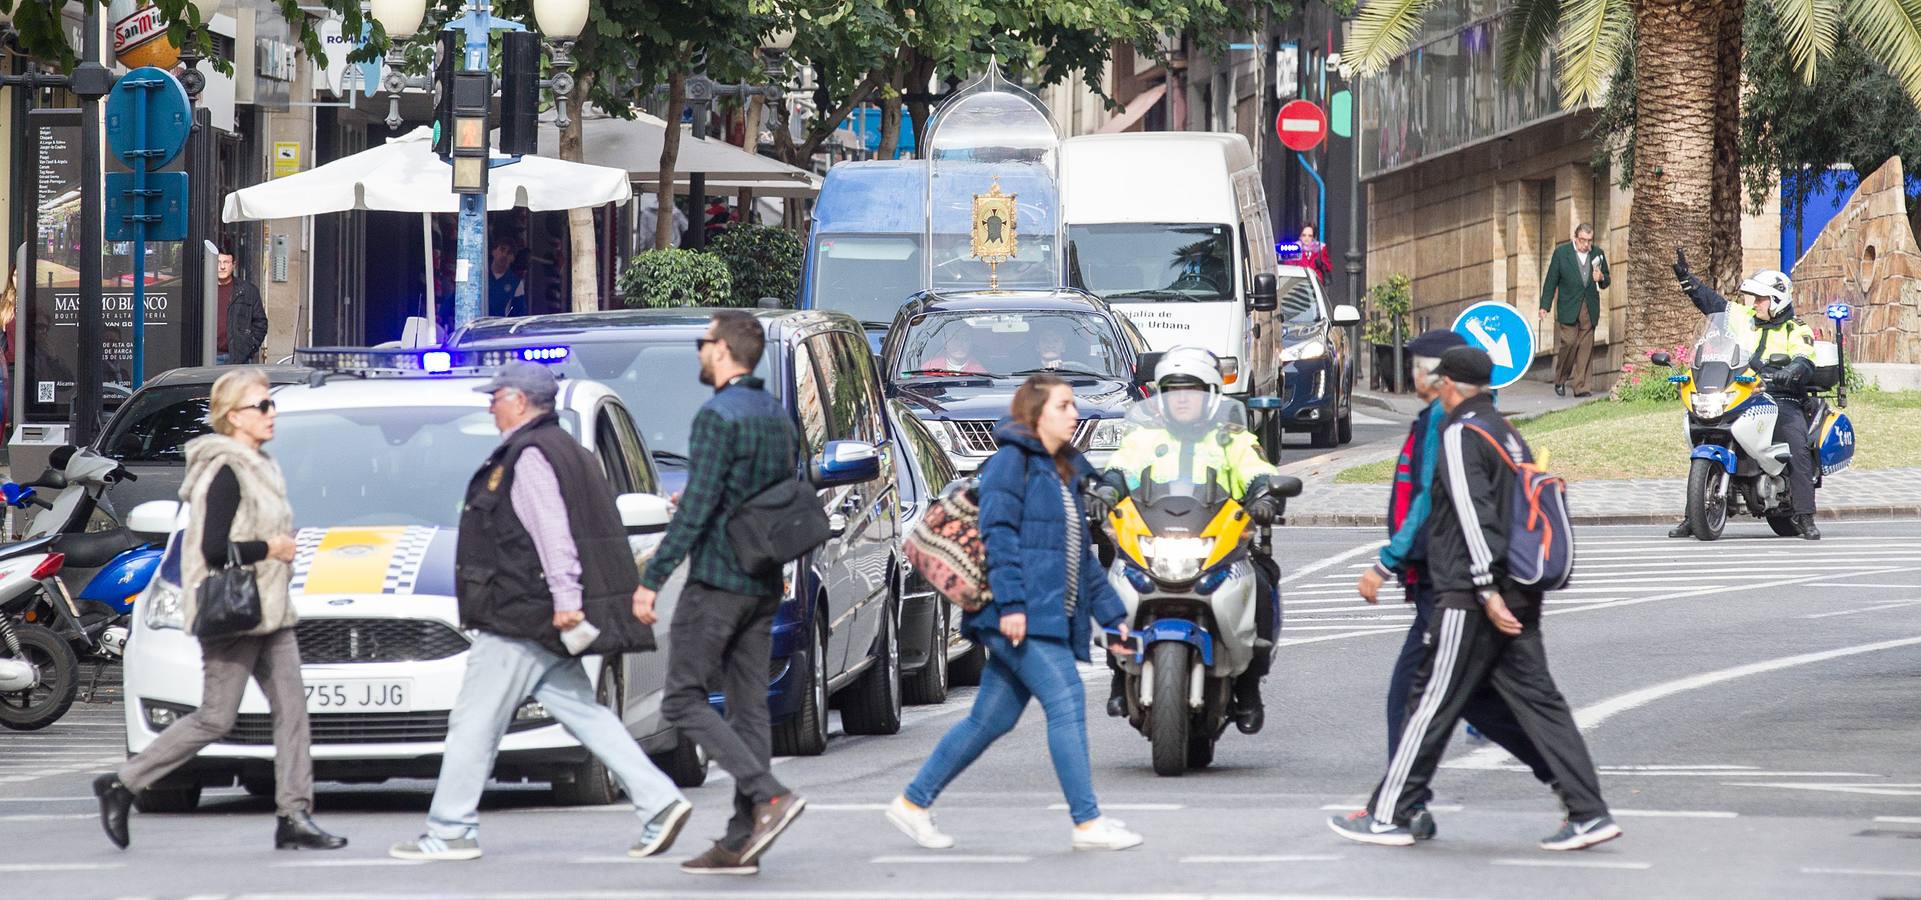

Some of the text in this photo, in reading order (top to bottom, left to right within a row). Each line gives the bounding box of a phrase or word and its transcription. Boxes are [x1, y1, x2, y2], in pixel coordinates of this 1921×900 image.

[327, 36, 370, 44] ROMN
[1148, 321, 1190, 330] Urbana
[304, 685, 403, 706] 755 JJG
